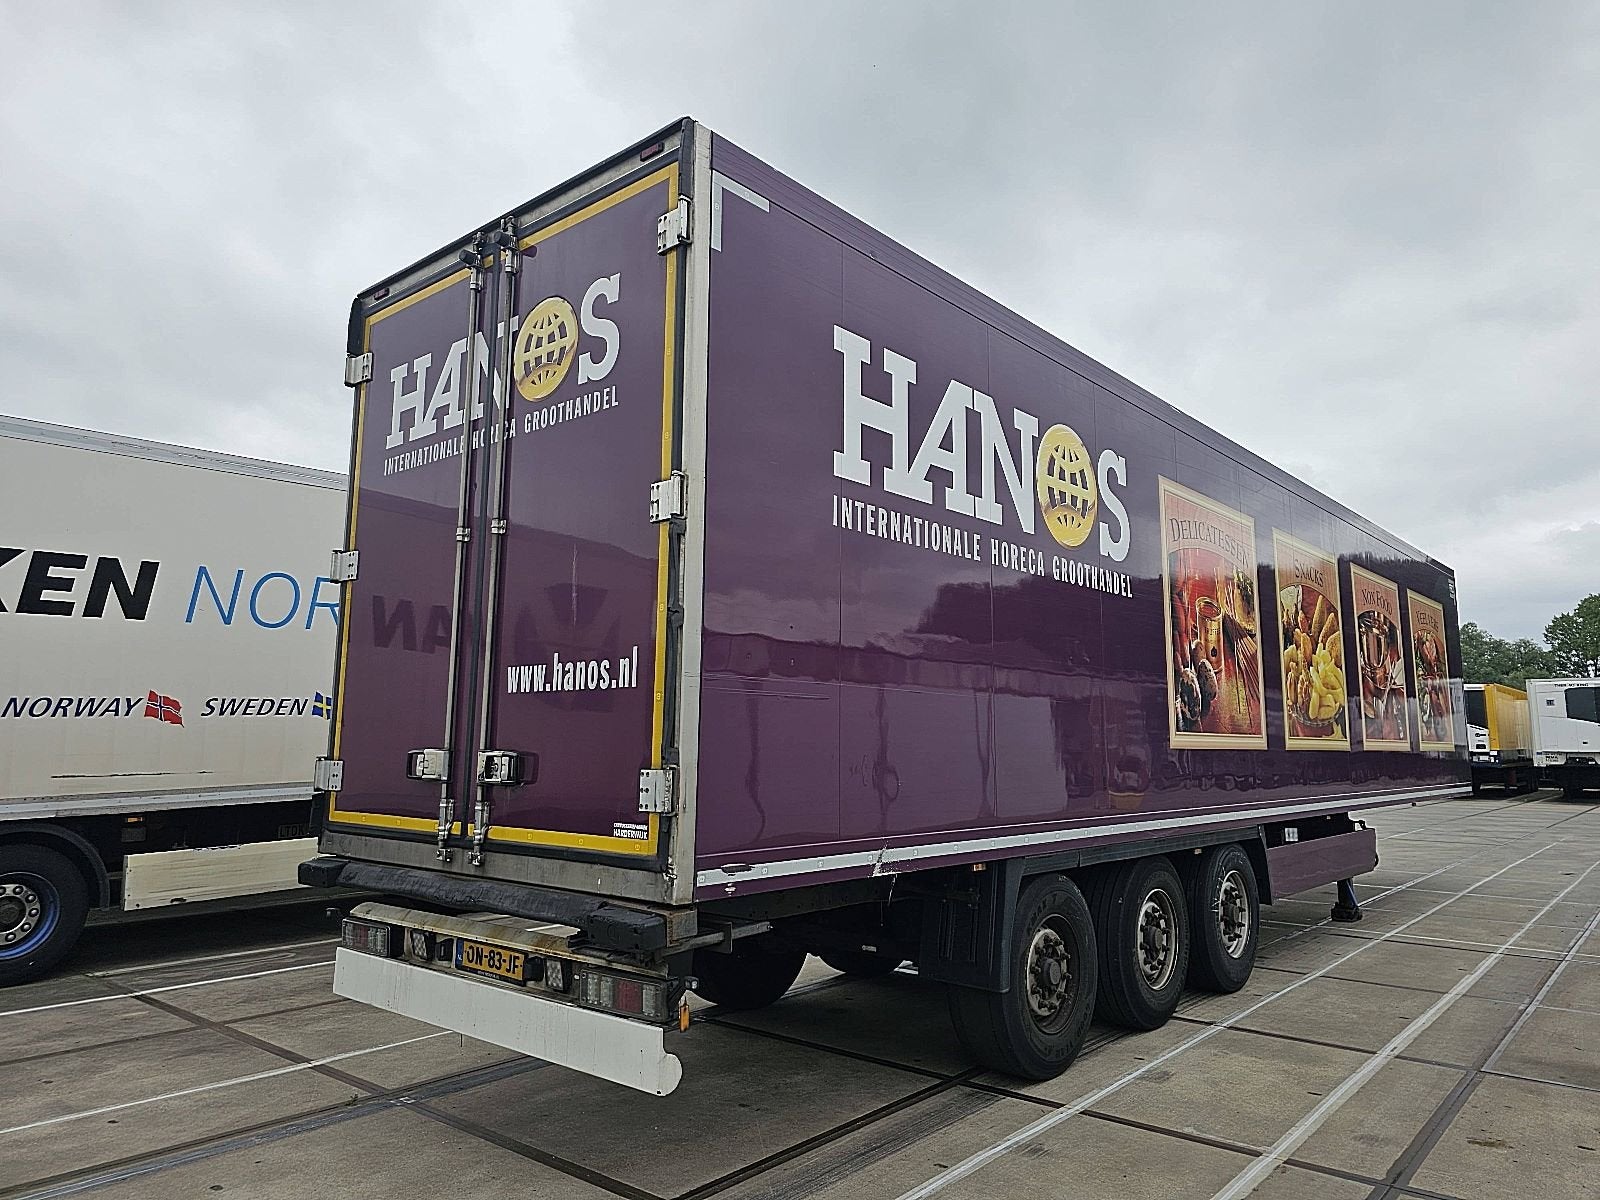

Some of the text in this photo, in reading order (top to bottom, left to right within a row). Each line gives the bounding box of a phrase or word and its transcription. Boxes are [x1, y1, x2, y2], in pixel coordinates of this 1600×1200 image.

[386, 273, 621, 450] HANOS
[524, 386, 619, 433] GROOTHANDEL
[833, 324, 1131, 562] HANOS
[832, 495, 1133, 598] INTERNATIONALE HORECA GROOTHANDEL
[1169, 518, 1250, 569] DELICATESSEN
[1294, 559, 1324, 587] SNACKS
[507, 646, 638, 693] www.hanos.nl
[1, 697, 308, 719] NORWAY SWEDEN
